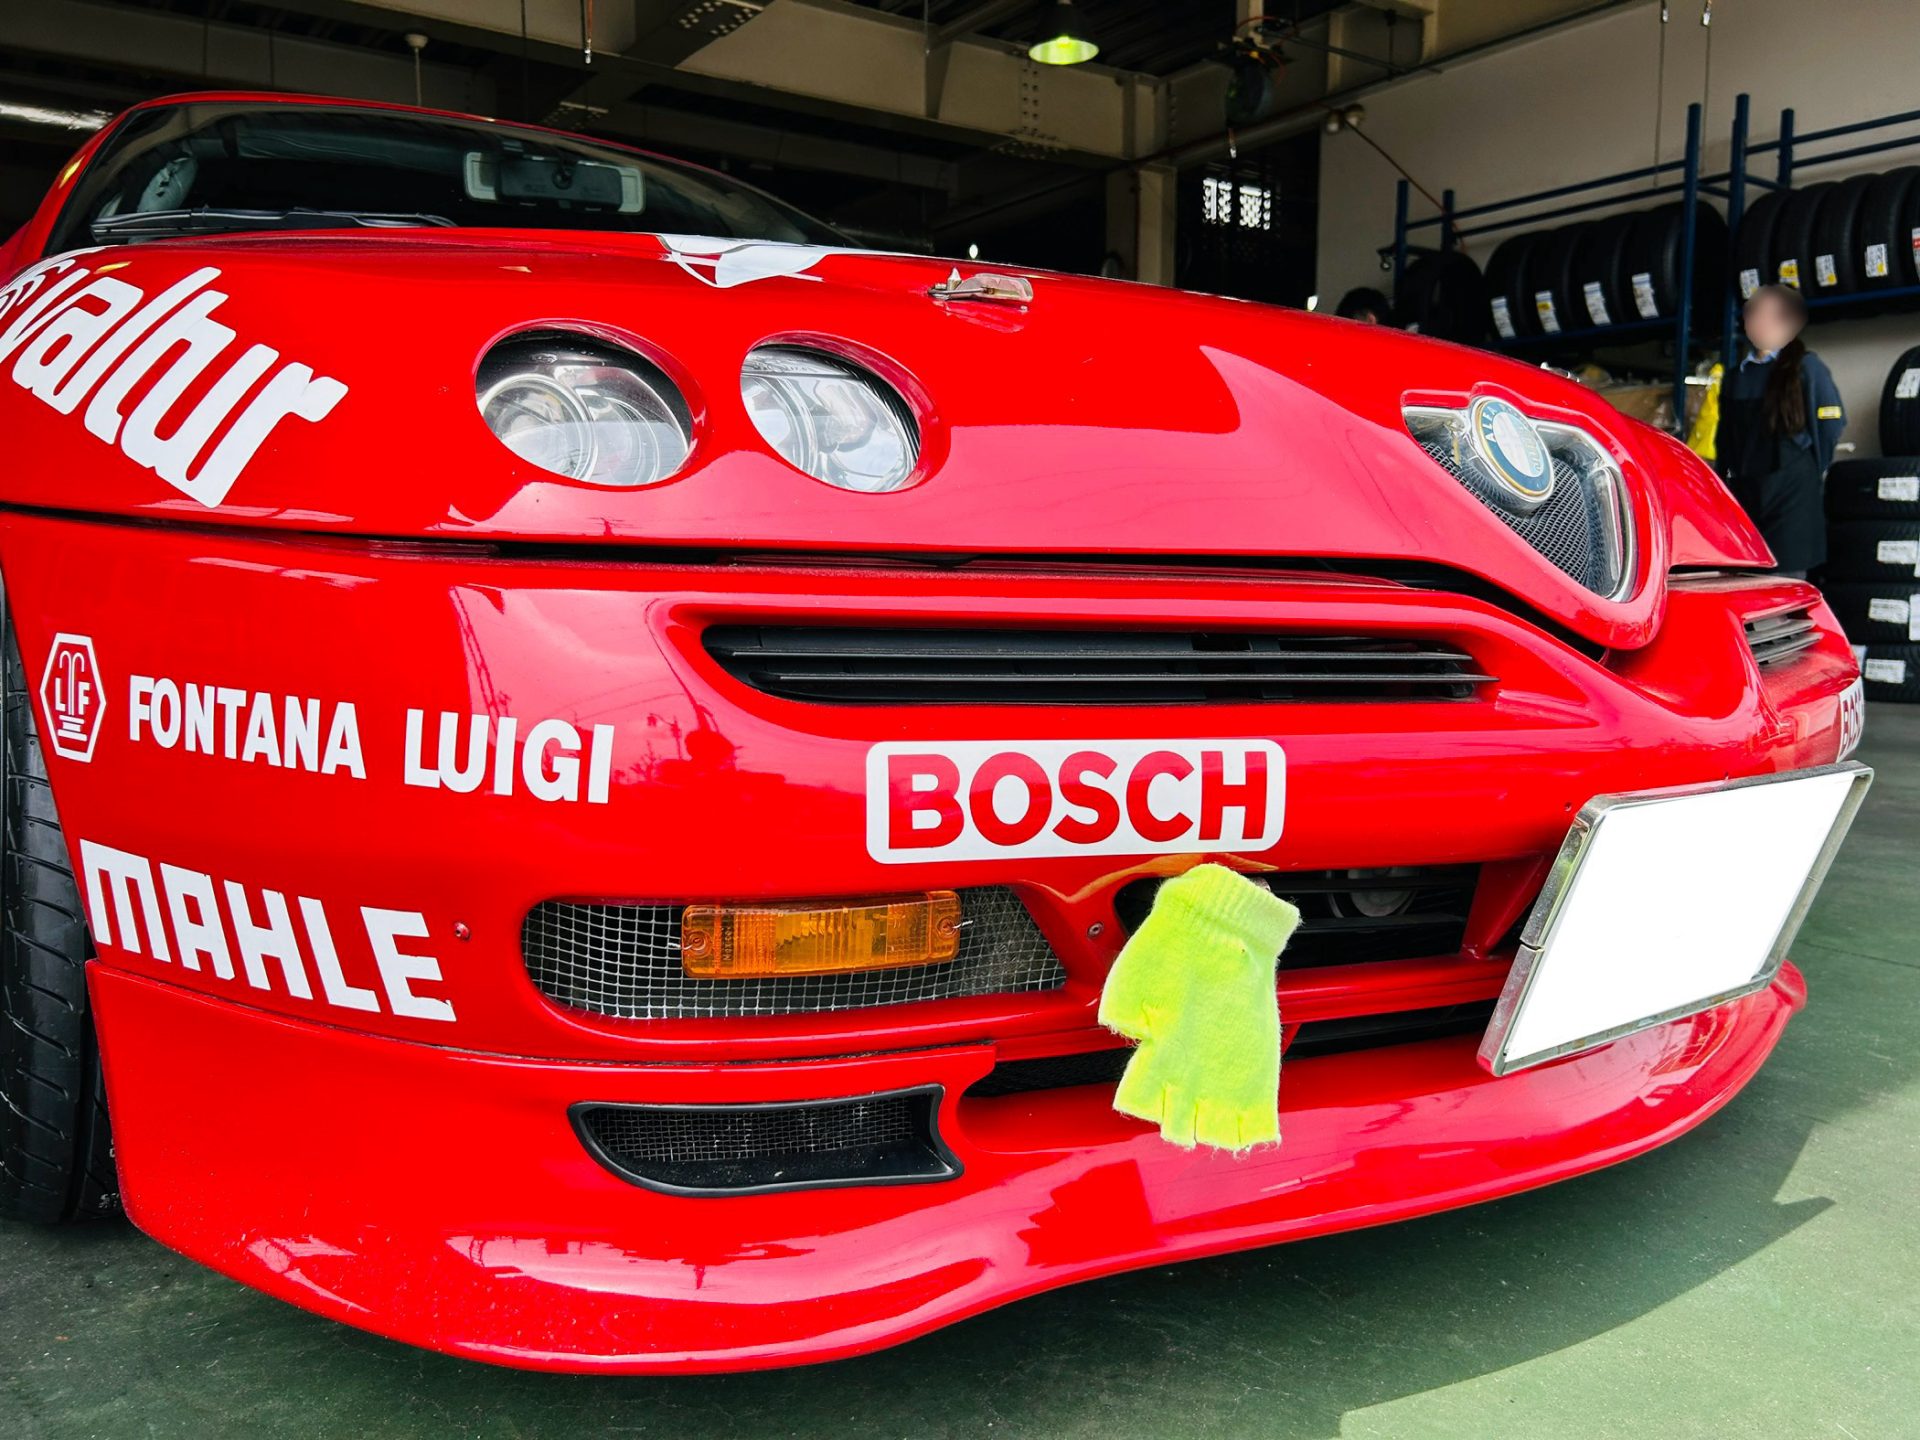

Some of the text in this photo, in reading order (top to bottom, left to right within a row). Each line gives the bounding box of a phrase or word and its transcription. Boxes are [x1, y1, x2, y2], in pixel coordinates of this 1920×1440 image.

[1482, 405, 1498, 443] ALFA
[129, 675, 616, 804] FONTANA LUIGI
[887, 750, 1268, 850] BOSCH
[80, 838, 457, 1023] MAHLE
